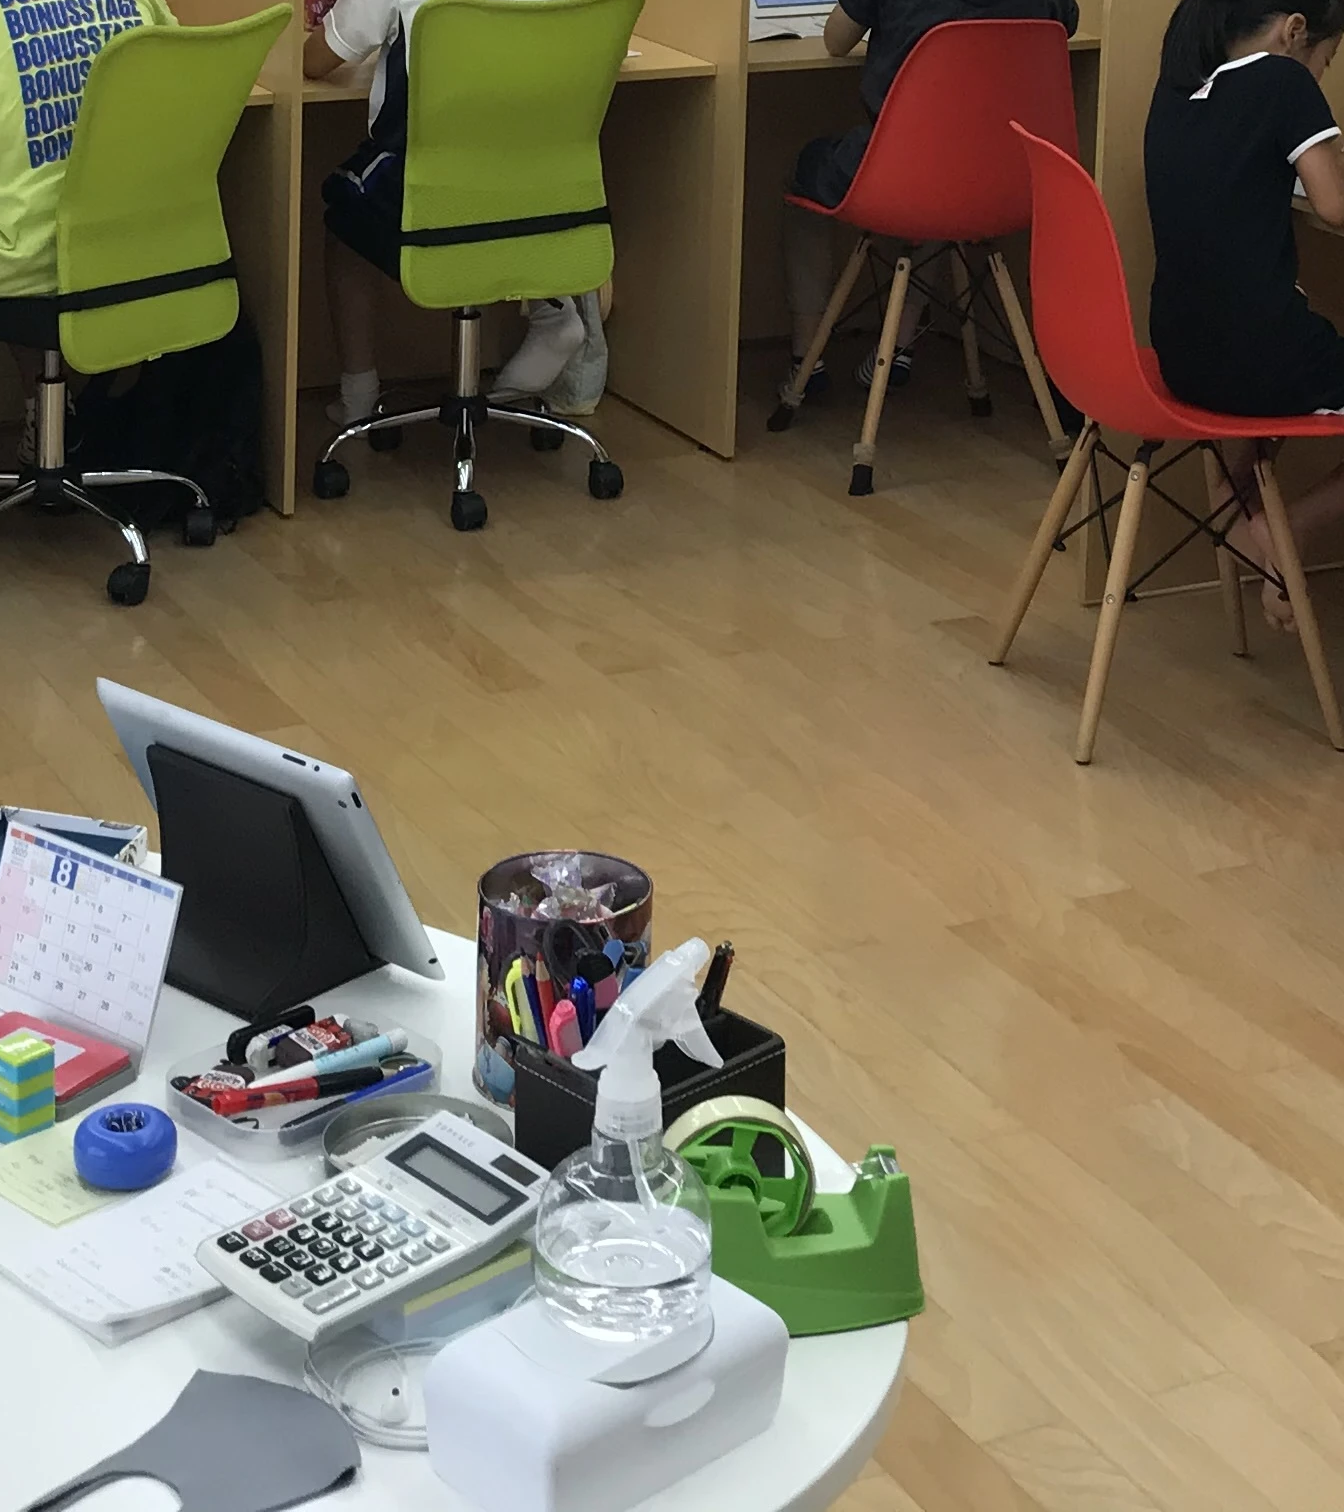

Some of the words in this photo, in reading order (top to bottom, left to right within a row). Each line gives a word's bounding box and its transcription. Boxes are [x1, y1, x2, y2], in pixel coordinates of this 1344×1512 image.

[56, 858, 73, 886] 8
[29, 877, 34, 886] 3
[52, 887, 57, 895] 4
[97, 904, 104, 914] 6
[121, 914, 128, 923] 7
[44, 914, 52, 925] 11
[67, 923, 76, 934] 12
[90, 933, 99, 944] 13
[113, 942, 123, 953] 14
[16, 933, 25, 943] 17
[38, 943, 47, 953] 18
[83, 961, 93, 973] 20
[106, 971, 116, 982] 21
[8, 974, 16, 985] 31
[10, 960, 19, 971] 24
[33, 970, 42, 981] 25
[55, 980, 65, 991] 26
[77, 989, 87, 1001] 27
[100, 1000, 110, 1011] 28
